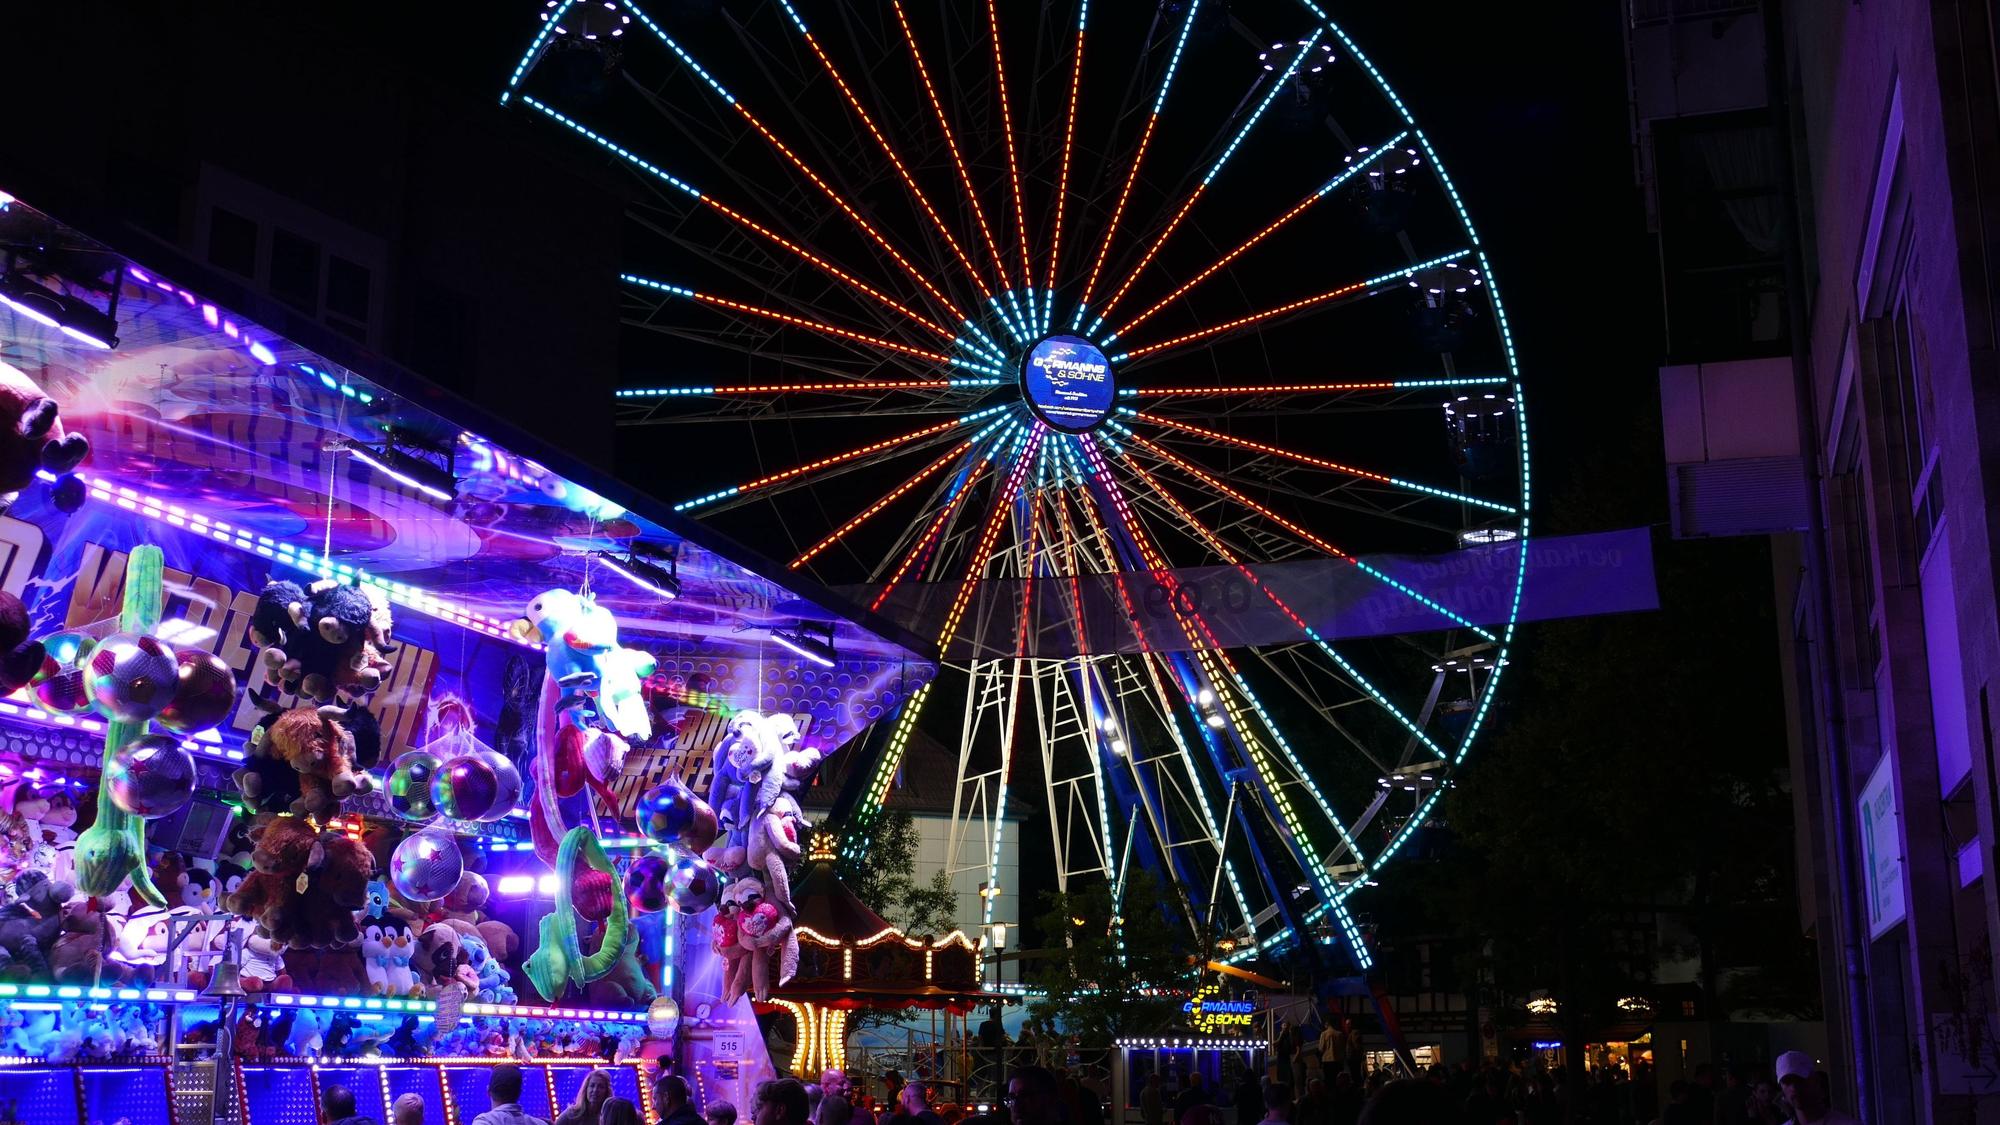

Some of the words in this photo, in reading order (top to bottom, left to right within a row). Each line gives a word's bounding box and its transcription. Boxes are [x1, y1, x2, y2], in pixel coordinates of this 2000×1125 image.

[1057, 369, 1067, 379] &
[621, 748, 715, 793] WERFE
[1206, 1013, 1215, 1025] &
[720, 1041, 737, 1051] 515
